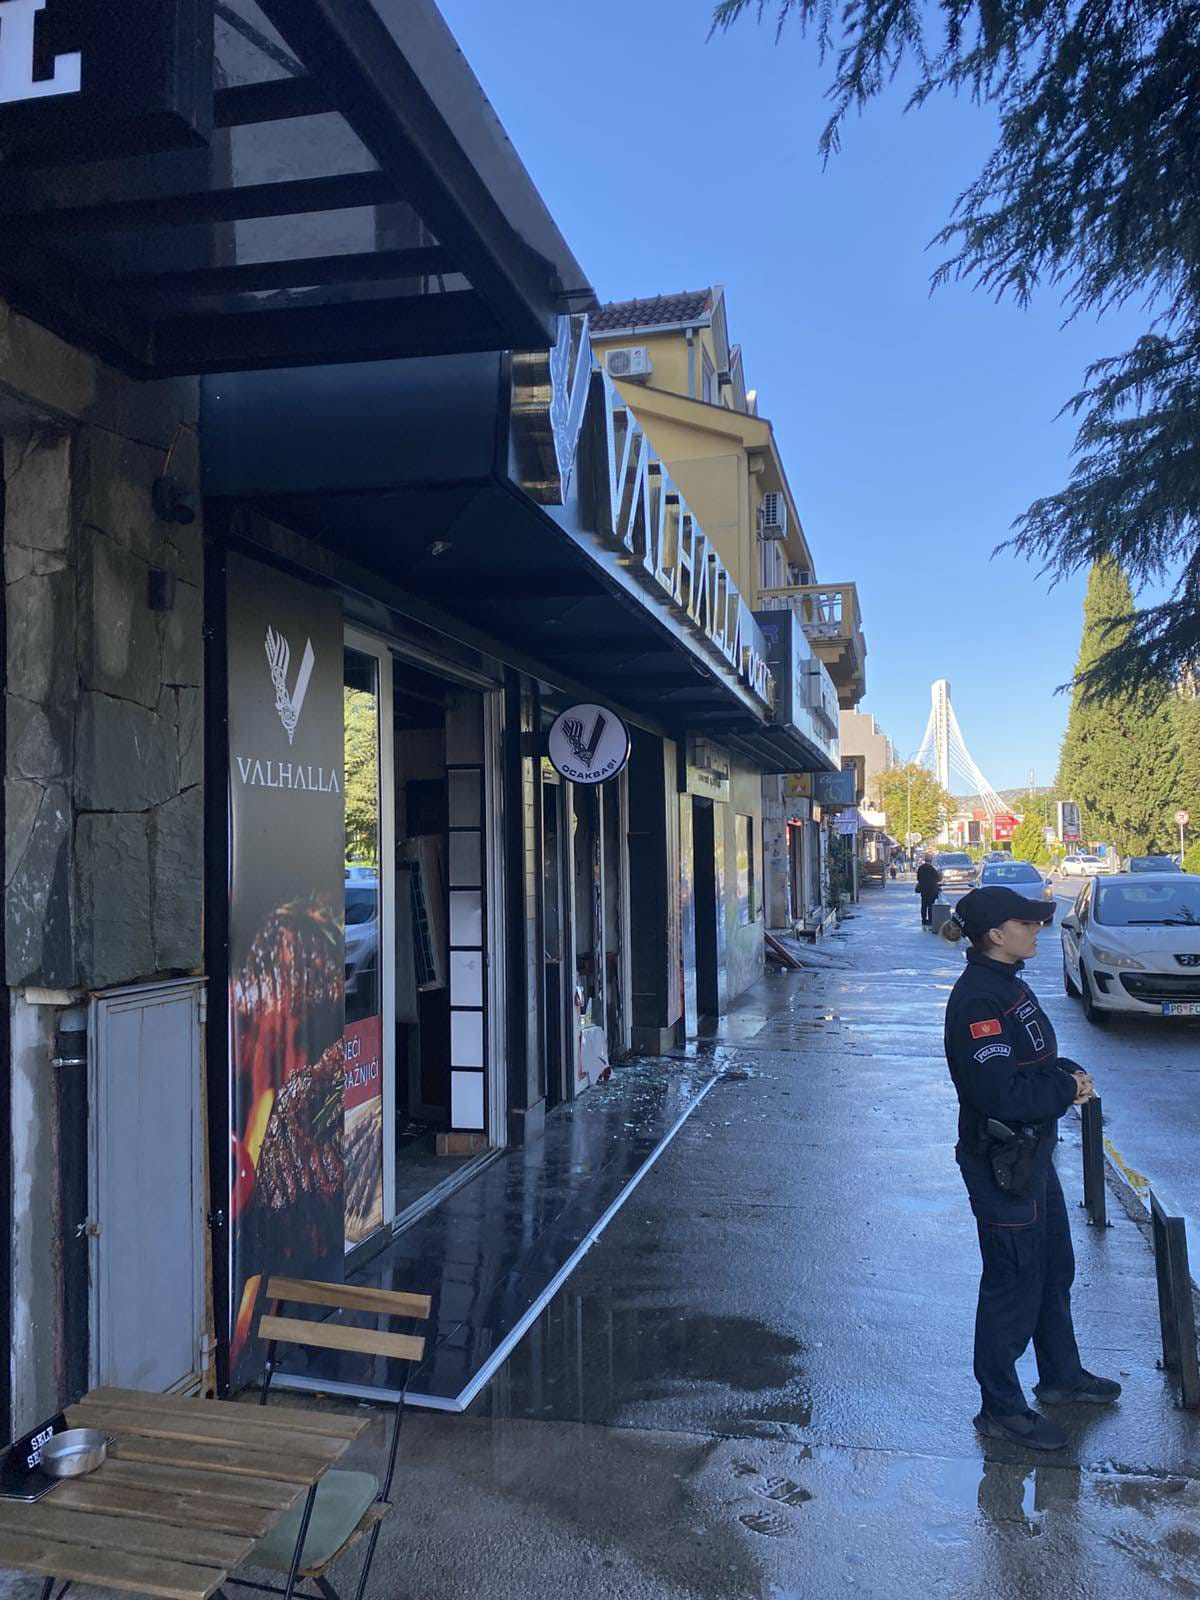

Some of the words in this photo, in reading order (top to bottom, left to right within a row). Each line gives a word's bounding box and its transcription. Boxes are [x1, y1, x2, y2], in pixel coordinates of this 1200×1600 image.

[602, 366, 744, 678] VALHALLA
[236, 757, 340, 793] VALHALLA
[978, 1046, 1008, 1060] POLICIJA
